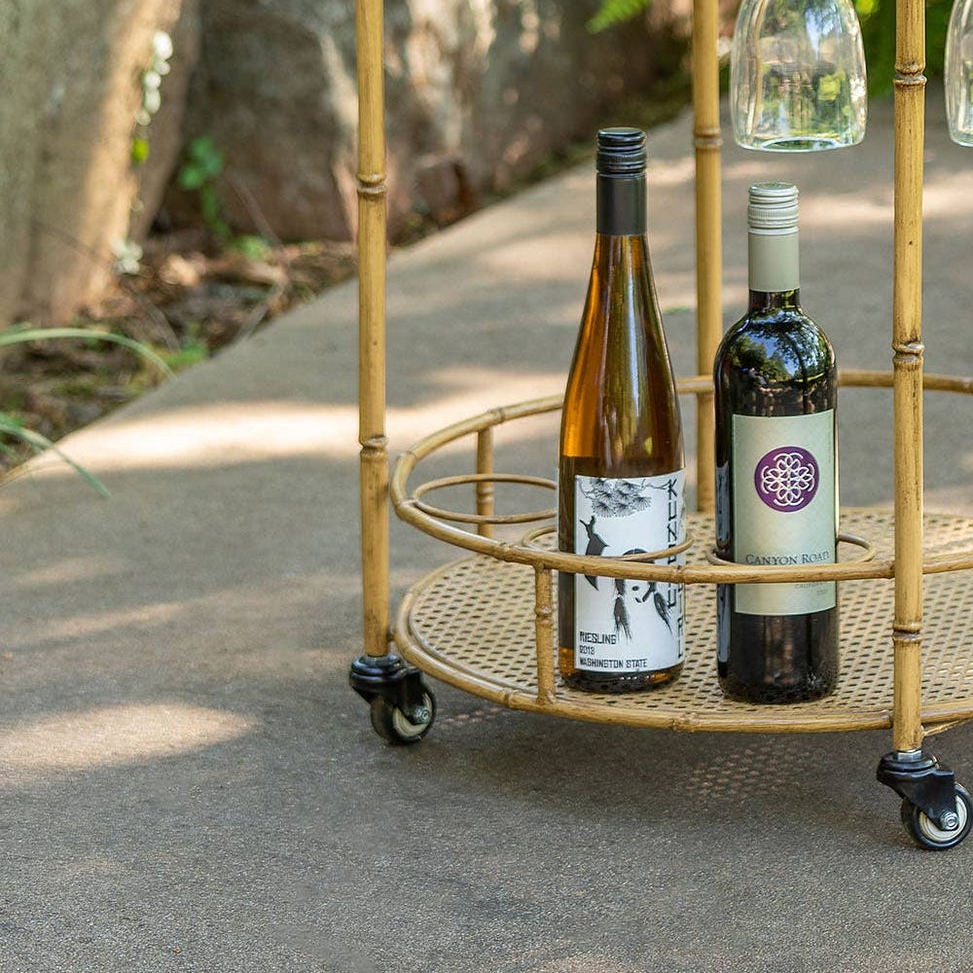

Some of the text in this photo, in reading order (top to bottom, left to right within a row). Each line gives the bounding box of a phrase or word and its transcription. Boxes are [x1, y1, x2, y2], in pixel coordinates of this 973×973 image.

[667, 478, 678, 609] KUNGU
[745, 550, 829, 565] CANYON ROAD
[579, 631, 617, 645] RIESLING
[579, 657, 648, 669] WASHINGTON STATE
